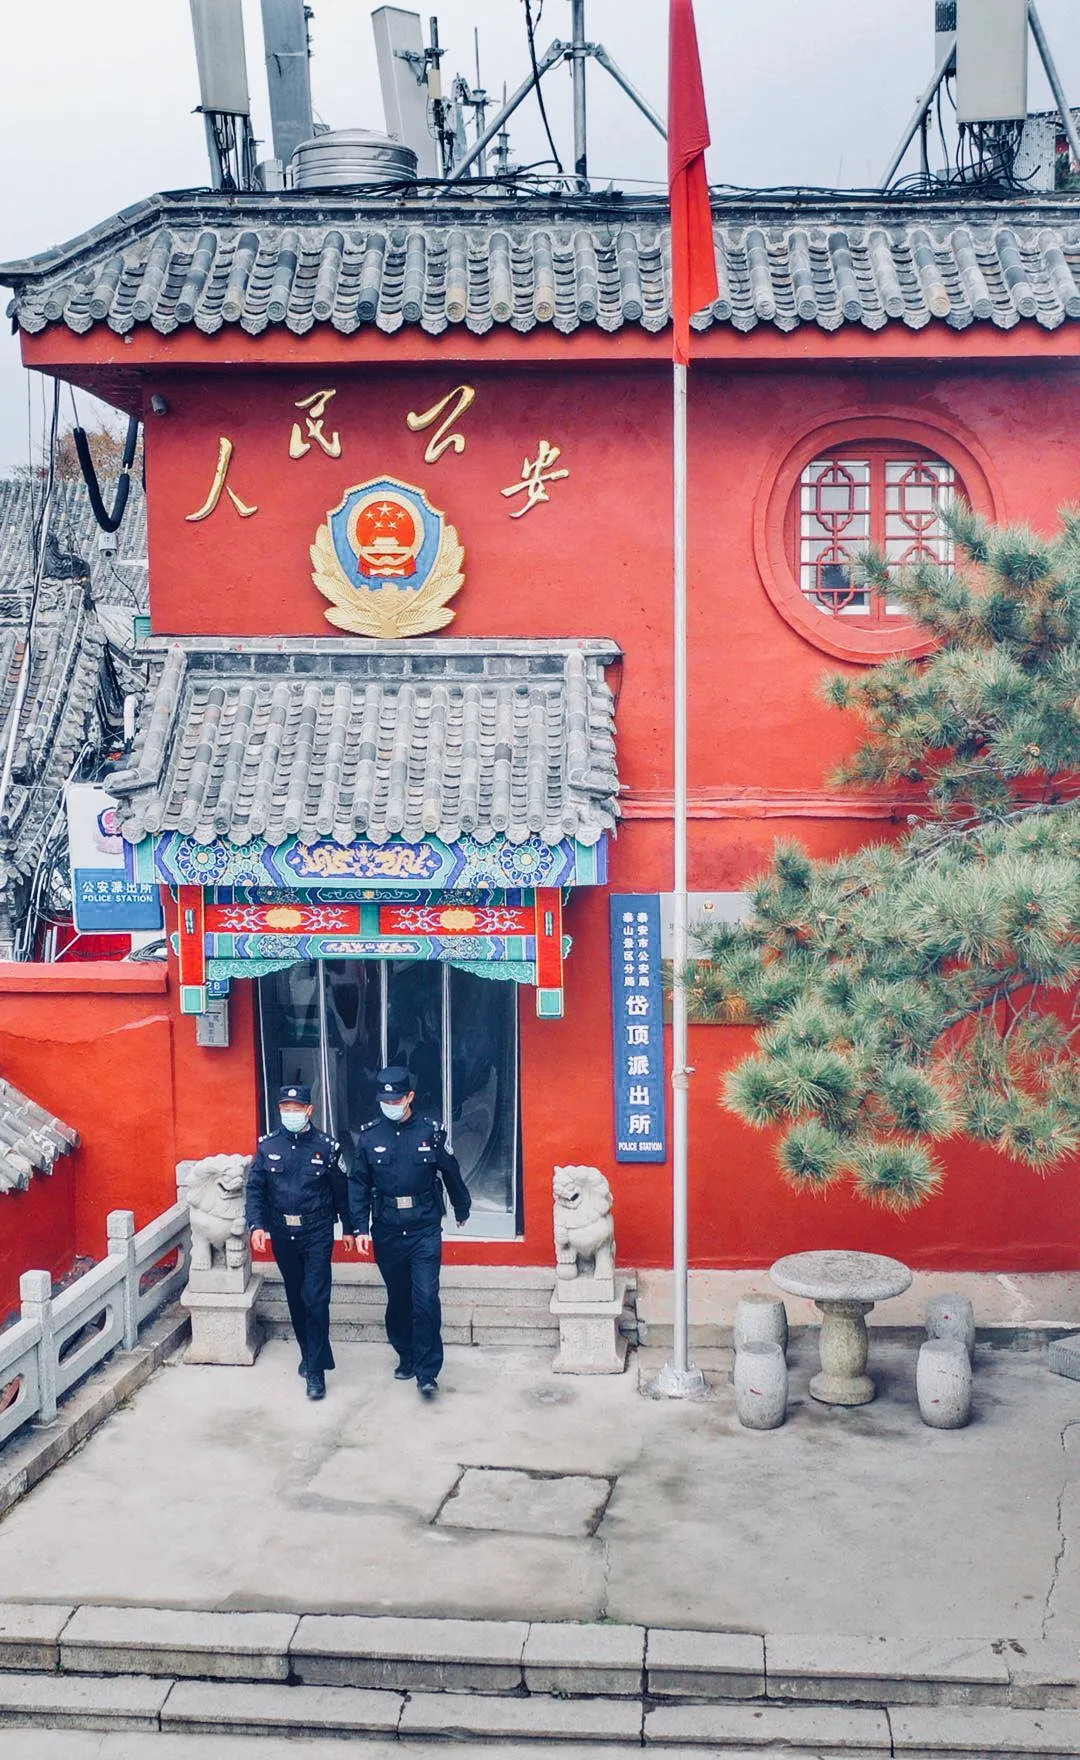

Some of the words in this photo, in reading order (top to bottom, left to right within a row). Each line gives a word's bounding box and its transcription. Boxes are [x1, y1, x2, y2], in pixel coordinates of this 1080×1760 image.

[184, 384, 571, 520] 人民公安
[82, 881, 153, 894] 公安派出所
[82, 894, 112, 903] POLICE
[115, 894, 153, 903] STATION
[622, 911, 636, 988] 泰山景区分局
[637, 911, 650, 988] 泰安市公安局
[625, 995, 651, 1135] 岱顶派出所
[618, 1141, 638, 1151] POLICE
[638, 1141, 663, 1151] STATION
